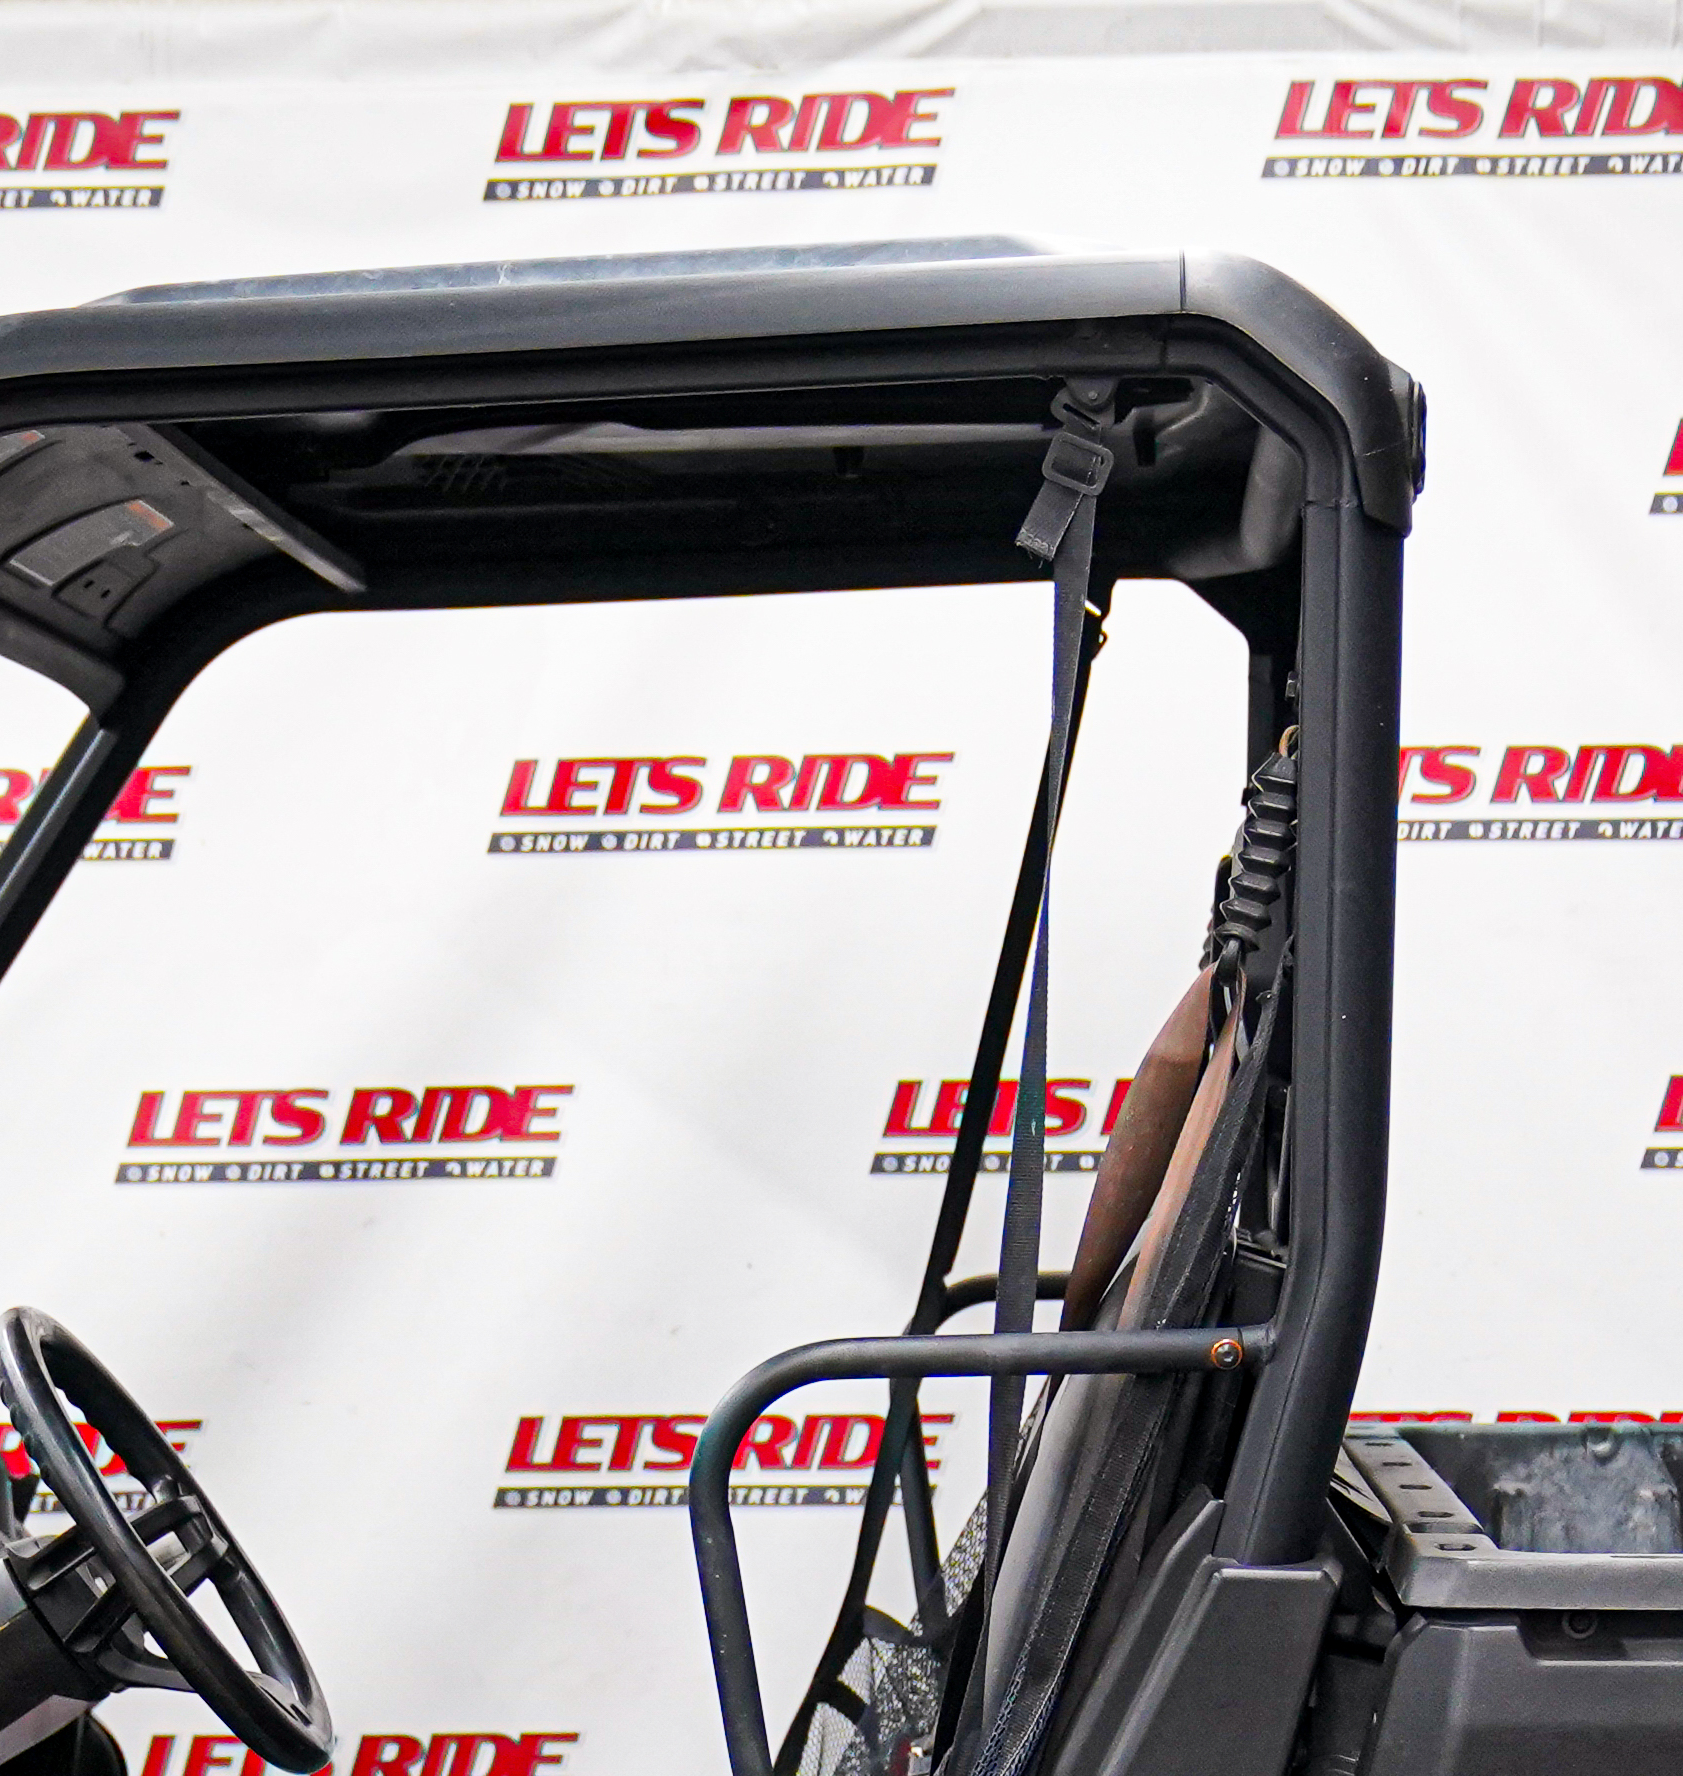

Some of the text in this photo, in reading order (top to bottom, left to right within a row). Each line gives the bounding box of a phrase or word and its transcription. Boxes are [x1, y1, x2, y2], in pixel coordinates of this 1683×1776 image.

[1275, 78, 1489, 139] LETS
[495, 87, 955, 163] LETS RIDE
[1296, 160, 1364, 176] SNOW
[1402, 158, 1460, 175] DIRT
[1497, 156, 1592, 174] STREET
[516, 168, 923, 199] SNOW DIRT STREET WATER
[72, 190, 151, 206] WATER
[499, 751, 955, 817] LETS RIDE
[521, 829, 923, 851] SNOW DIRT STREET WATER
[1397, 823, 1454, 838] DIRT
[1490, 822, 1582, 838] STREET
[84, 843, 162, 860] WATER
[127, 1084, 575, 1147] LETS RIDE
[148, 1160, 543, 1181] SNOW DIRT STREET WATER
[505, 1415, 707, 1473] LETS
[527, 1489, 809, 1507] SNOW DIRT TREET
